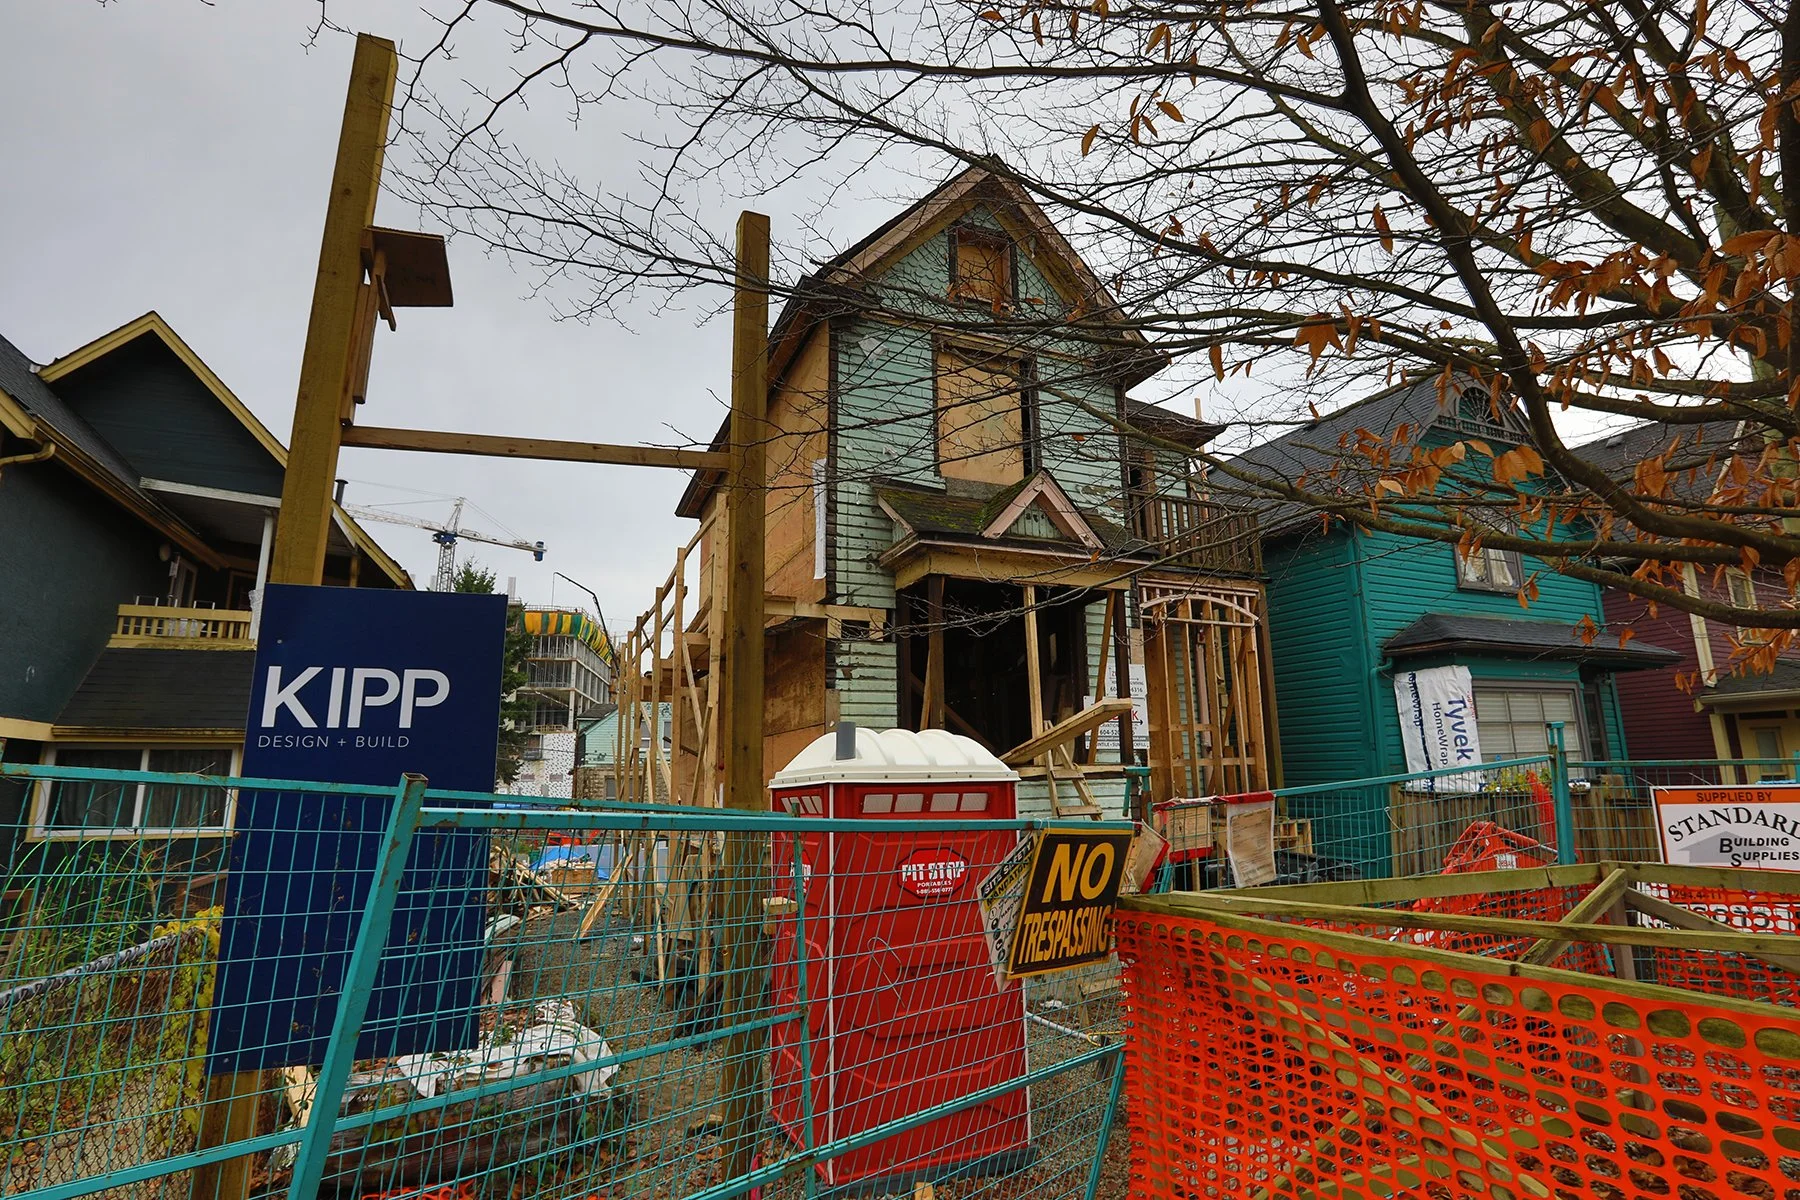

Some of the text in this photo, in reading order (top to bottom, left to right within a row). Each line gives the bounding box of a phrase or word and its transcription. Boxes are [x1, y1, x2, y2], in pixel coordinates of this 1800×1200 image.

[261, 665, 450, 729] KIPP
[258, 735, 329, 748] DESIGN
[355, 735, 410, 748] BUILD
[1432, 702, 1448, 766] HomeWrap
[1445, 696, 1474, 761] Tyvek
[1696, 791, 1773, 802] SUPPLIED BY
[1719, 837, 1790, 853] BUILDING
[1731, 851, 1800, 867] SUPPLIES
[902, 861, 965, 882] PIT STOP
[1041, 842, 1115, 903] NO
[1018, 905, 1112, 965] TRESPASSING
